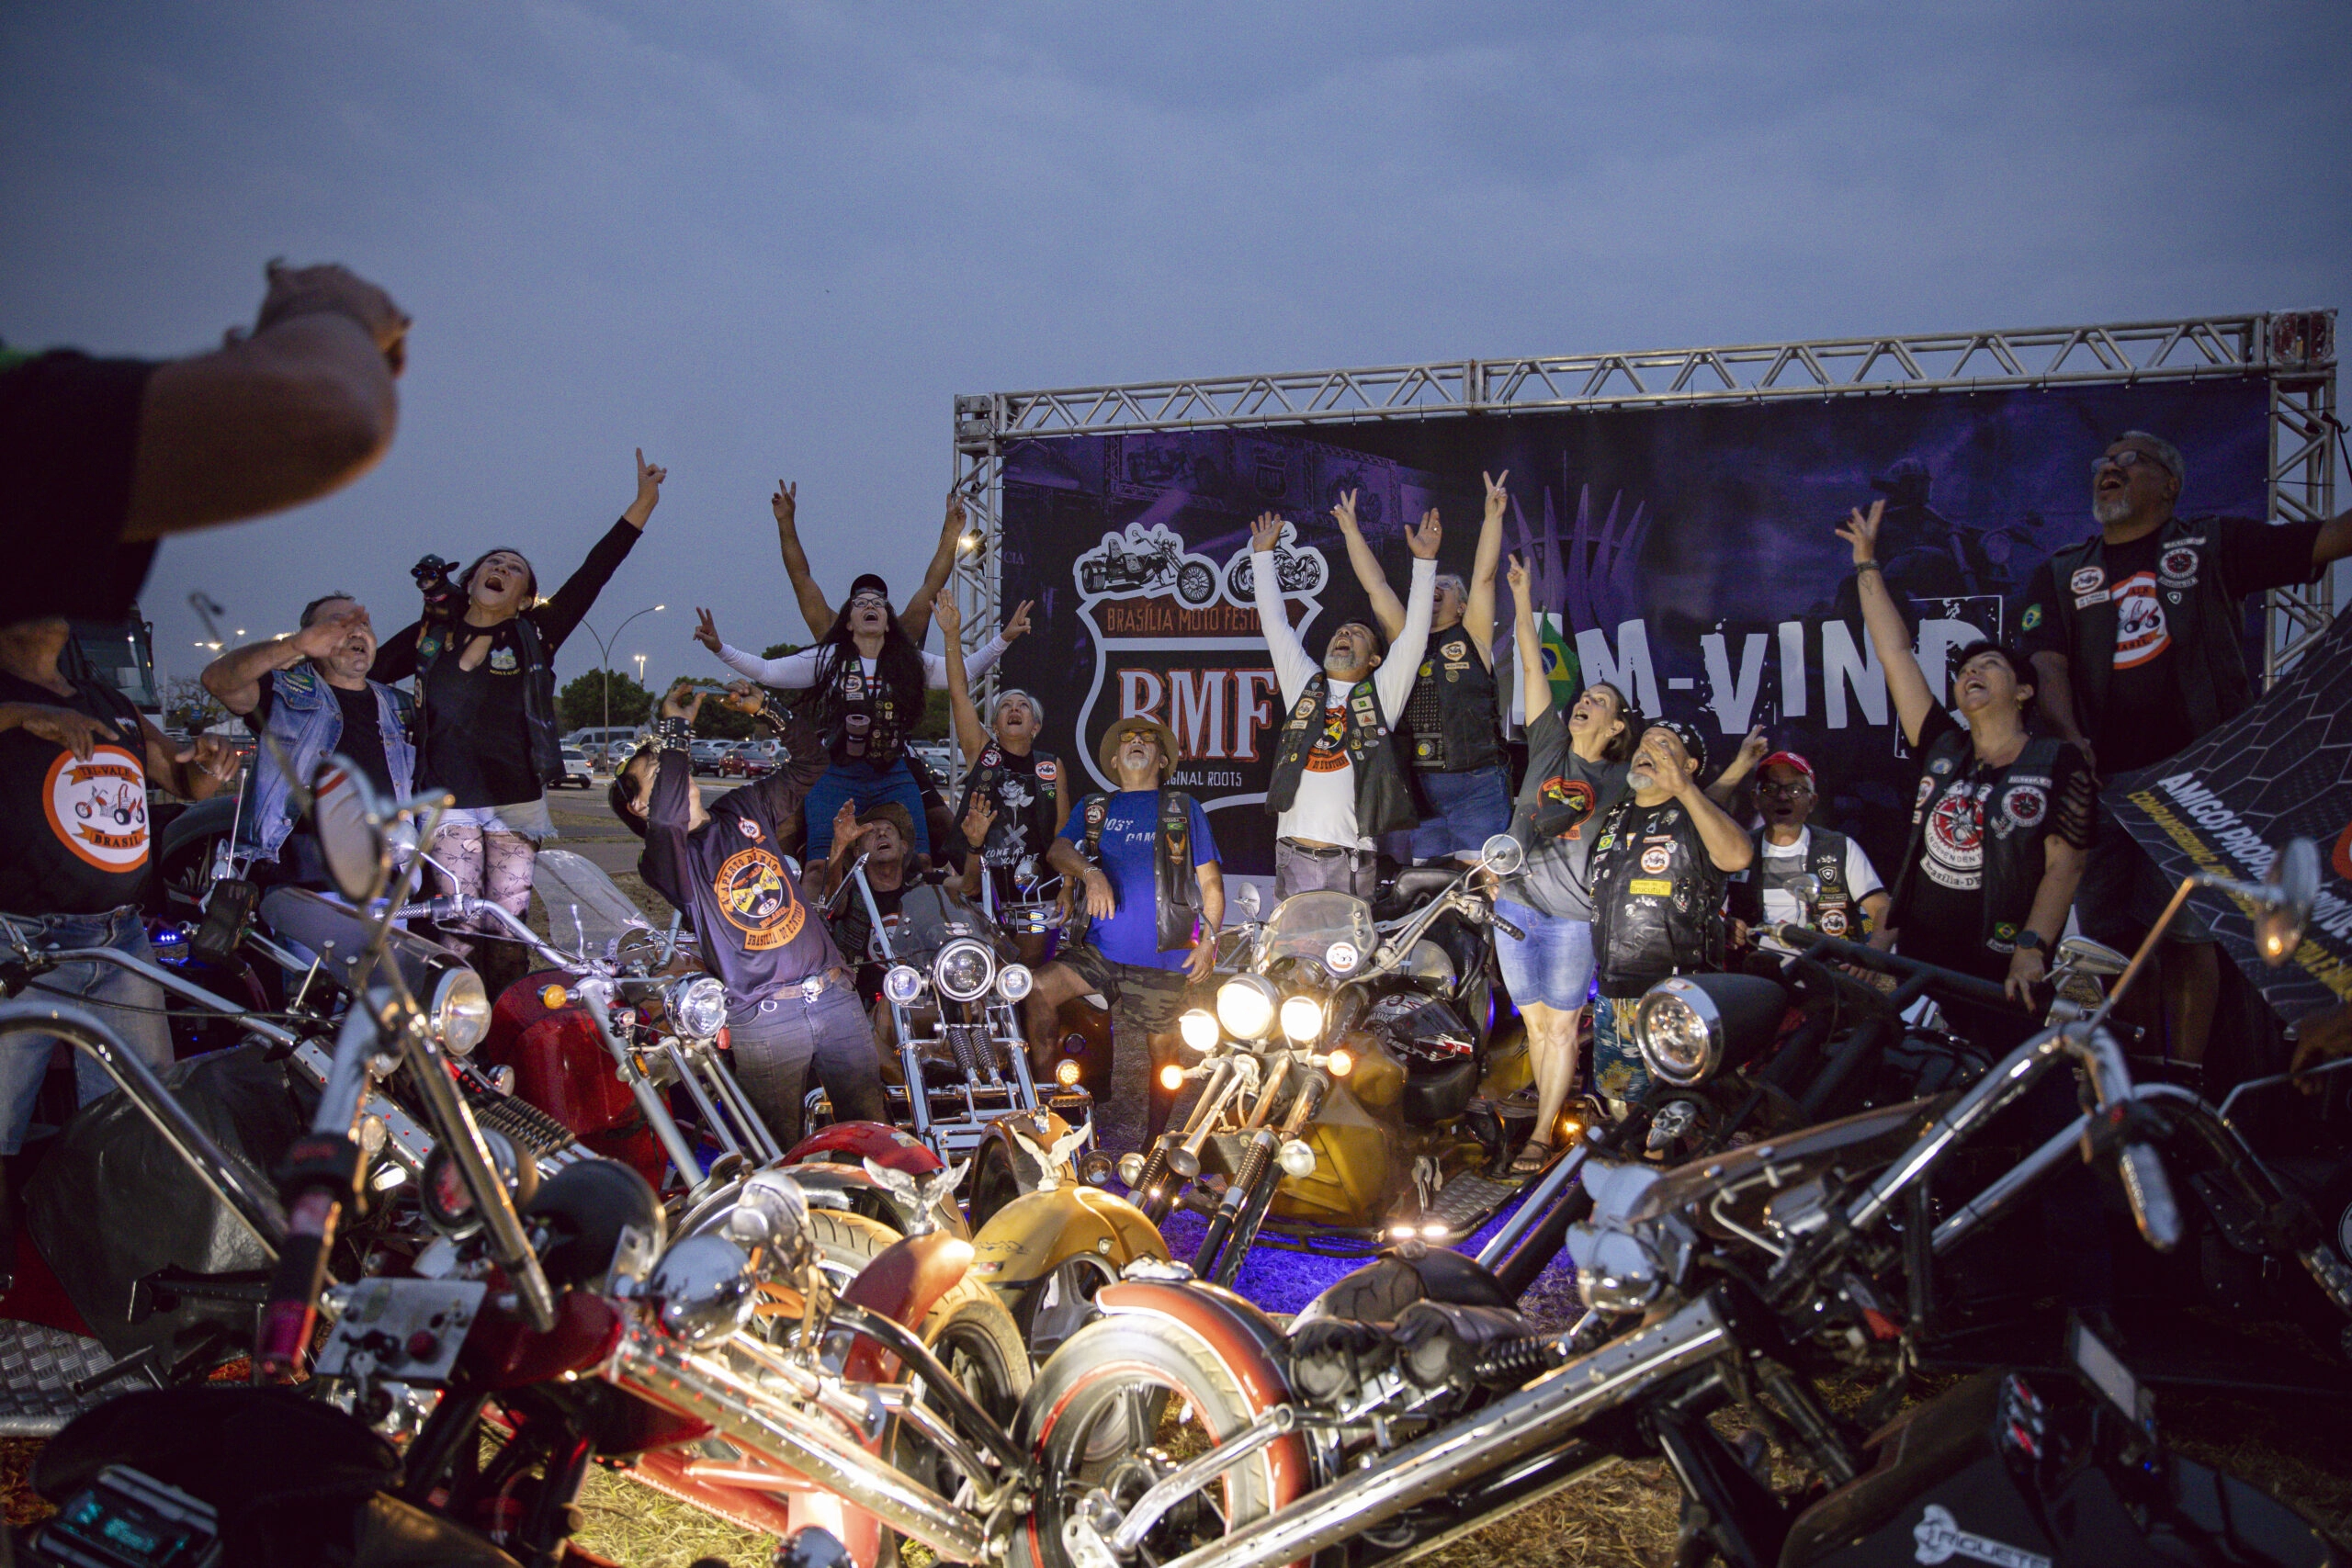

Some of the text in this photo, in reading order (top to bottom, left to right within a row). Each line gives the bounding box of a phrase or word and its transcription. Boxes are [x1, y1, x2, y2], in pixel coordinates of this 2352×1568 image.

[1106, 601, 1174, 632] BRASÍLIA
[1179, 606, 1220, 632] MOTO
[1207, 770, 1242, 788] ROOTS
[2157, 773, 2243, 830] AMIGOS
[94, 833, 141, 848] BRASIL
[985, 847, 1011, 858] COME
[1000, 855, 1018, 866] YOU
[721, 858, 745, 892] APERTO
